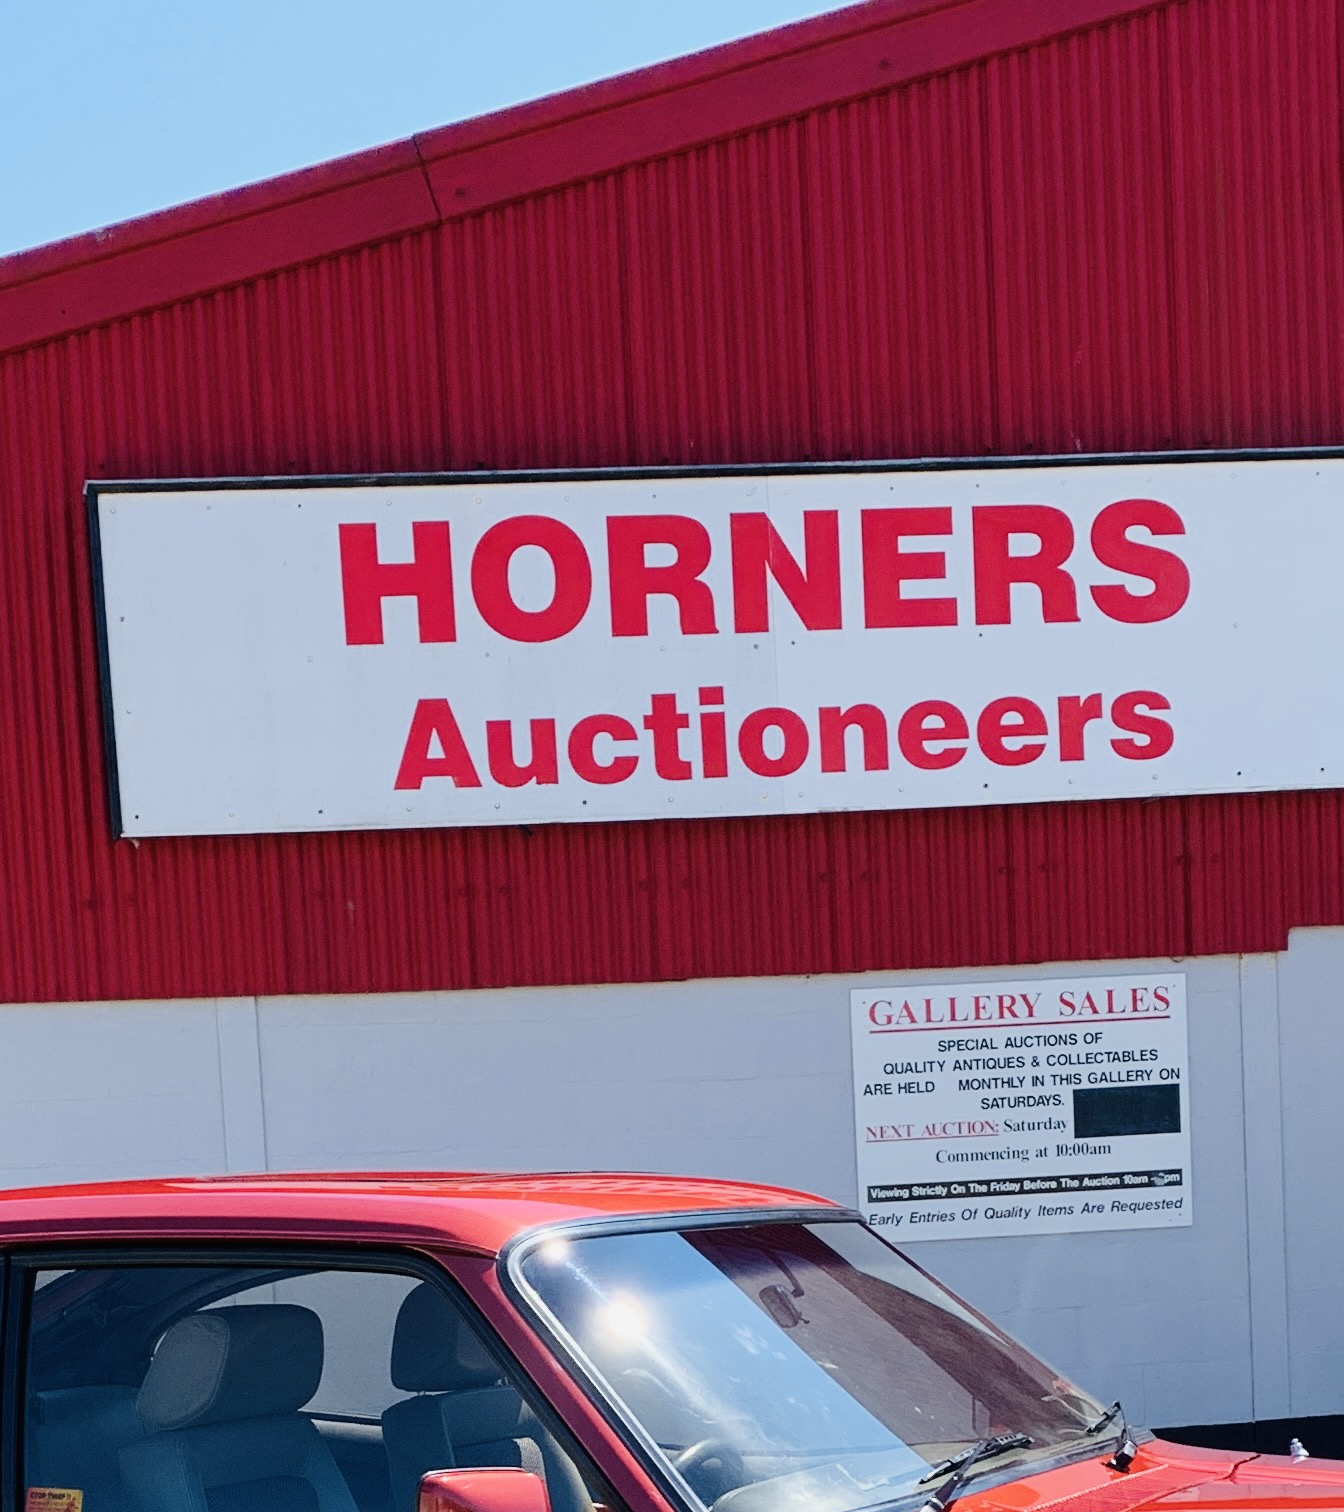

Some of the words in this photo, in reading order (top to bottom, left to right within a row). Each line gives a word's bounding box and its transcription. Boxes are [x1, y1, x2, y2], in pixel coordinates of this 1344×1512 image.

[336, 498, 1191, 647] HORNERS
[393, 685, 1175, 792] Auctioneers
[868, 992, 1043, 1027] GALLERY
[1059, 985, 1171, 1017] SALES
[937, 1038, 999, 1052] SPECIAL
[1004, 1033, 1078, 1049] AUCTIONS
[1083, 1032, 1103, 1045] OF
[883, 1060, 946, 1075] QUALITY
[952, 1056, 1026, 1072] ANTIQUES
[1031, 1055, 1040, 1067] &
[1046, 1049, 1159, 1066] COLLECTABLES
[863, 1083, 893, 1096] ARE
[898, 1081, 935, 1094] HELD
[958, 1076, 1026, 1091] MONTHLY
[1031, 1075, 1045, 1087] IN
[1050, 1073, 1082, 1085] THIS
[1087, 1069, 1153, 1084] GALLERY
[1159, 1068, 1180, 1080] ON
[980, 1094, 1065, 1110] SATURDAYS.
[866, 1123, 914, 1139] NEXT
[921, 1119, 999, 1137] AUCTION:
[1003, 1117, 1068, 1133] Saturday
[936, 1148, 1030, 1164] Commencing
[1035, 1147, 1048, 1158] at
[1056, 1142, 1112, 1157] 10:00am
[869, 1186, 910, 1199] Viewing
[912, 1185, 948, 1197] Strictly
[950, 1184, 966, 1194] On
[968, 1183, 988, 1193] The
[990, 1181, 1021, 1193] Friday
[1023, 1179, 1057, 1190] Before
[1060, 1178, 1080, 1188] The
[1082, 1176, 1120, 1187] Auction
[1122, 1175, 1149, 1185] 10am
[869, 1213, 903, 1227] Early
[909, 1210, 956, 1224] Entries
[961, 1208, 978, 1221] Of
[984, 1206, 1032, 1221] Quality
[1037, 1205, 1074, 1218] Items
[1080, 1202, 1105, 1214] Are
[1110, 1198, 1183, 1213] Requested
